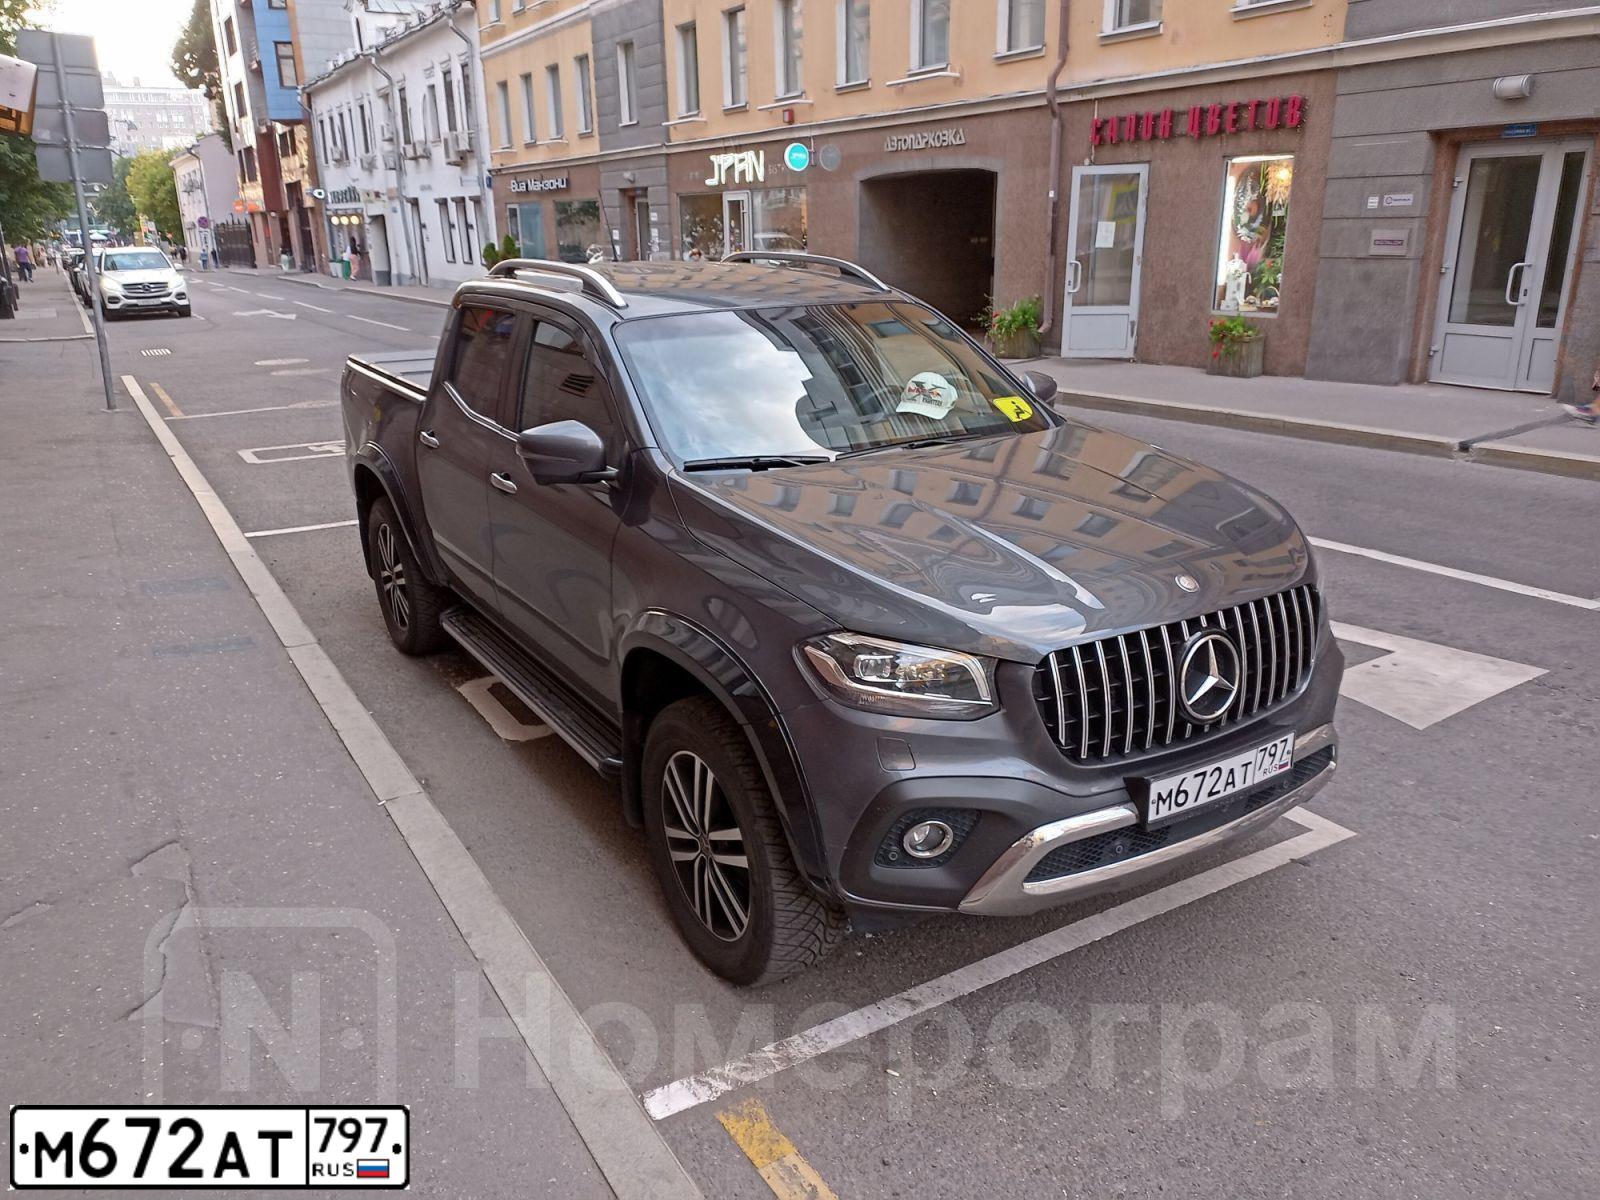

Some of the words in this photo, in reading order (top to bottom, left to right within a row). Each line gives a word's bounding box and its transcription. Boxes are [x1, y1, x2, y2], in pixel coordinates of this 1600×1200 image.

[1090, 107, 1173, 145] САЛОН
[1187, 95, 1302, 141] ЦВЕТОВ
[884, 128, 966, 152] АВТОПАРКОВКА
[1155, 761, 1253, 815] М672АТ
[1258, 738, 1289, 771] 797
[1262, 763, 1279, 776] RUS
